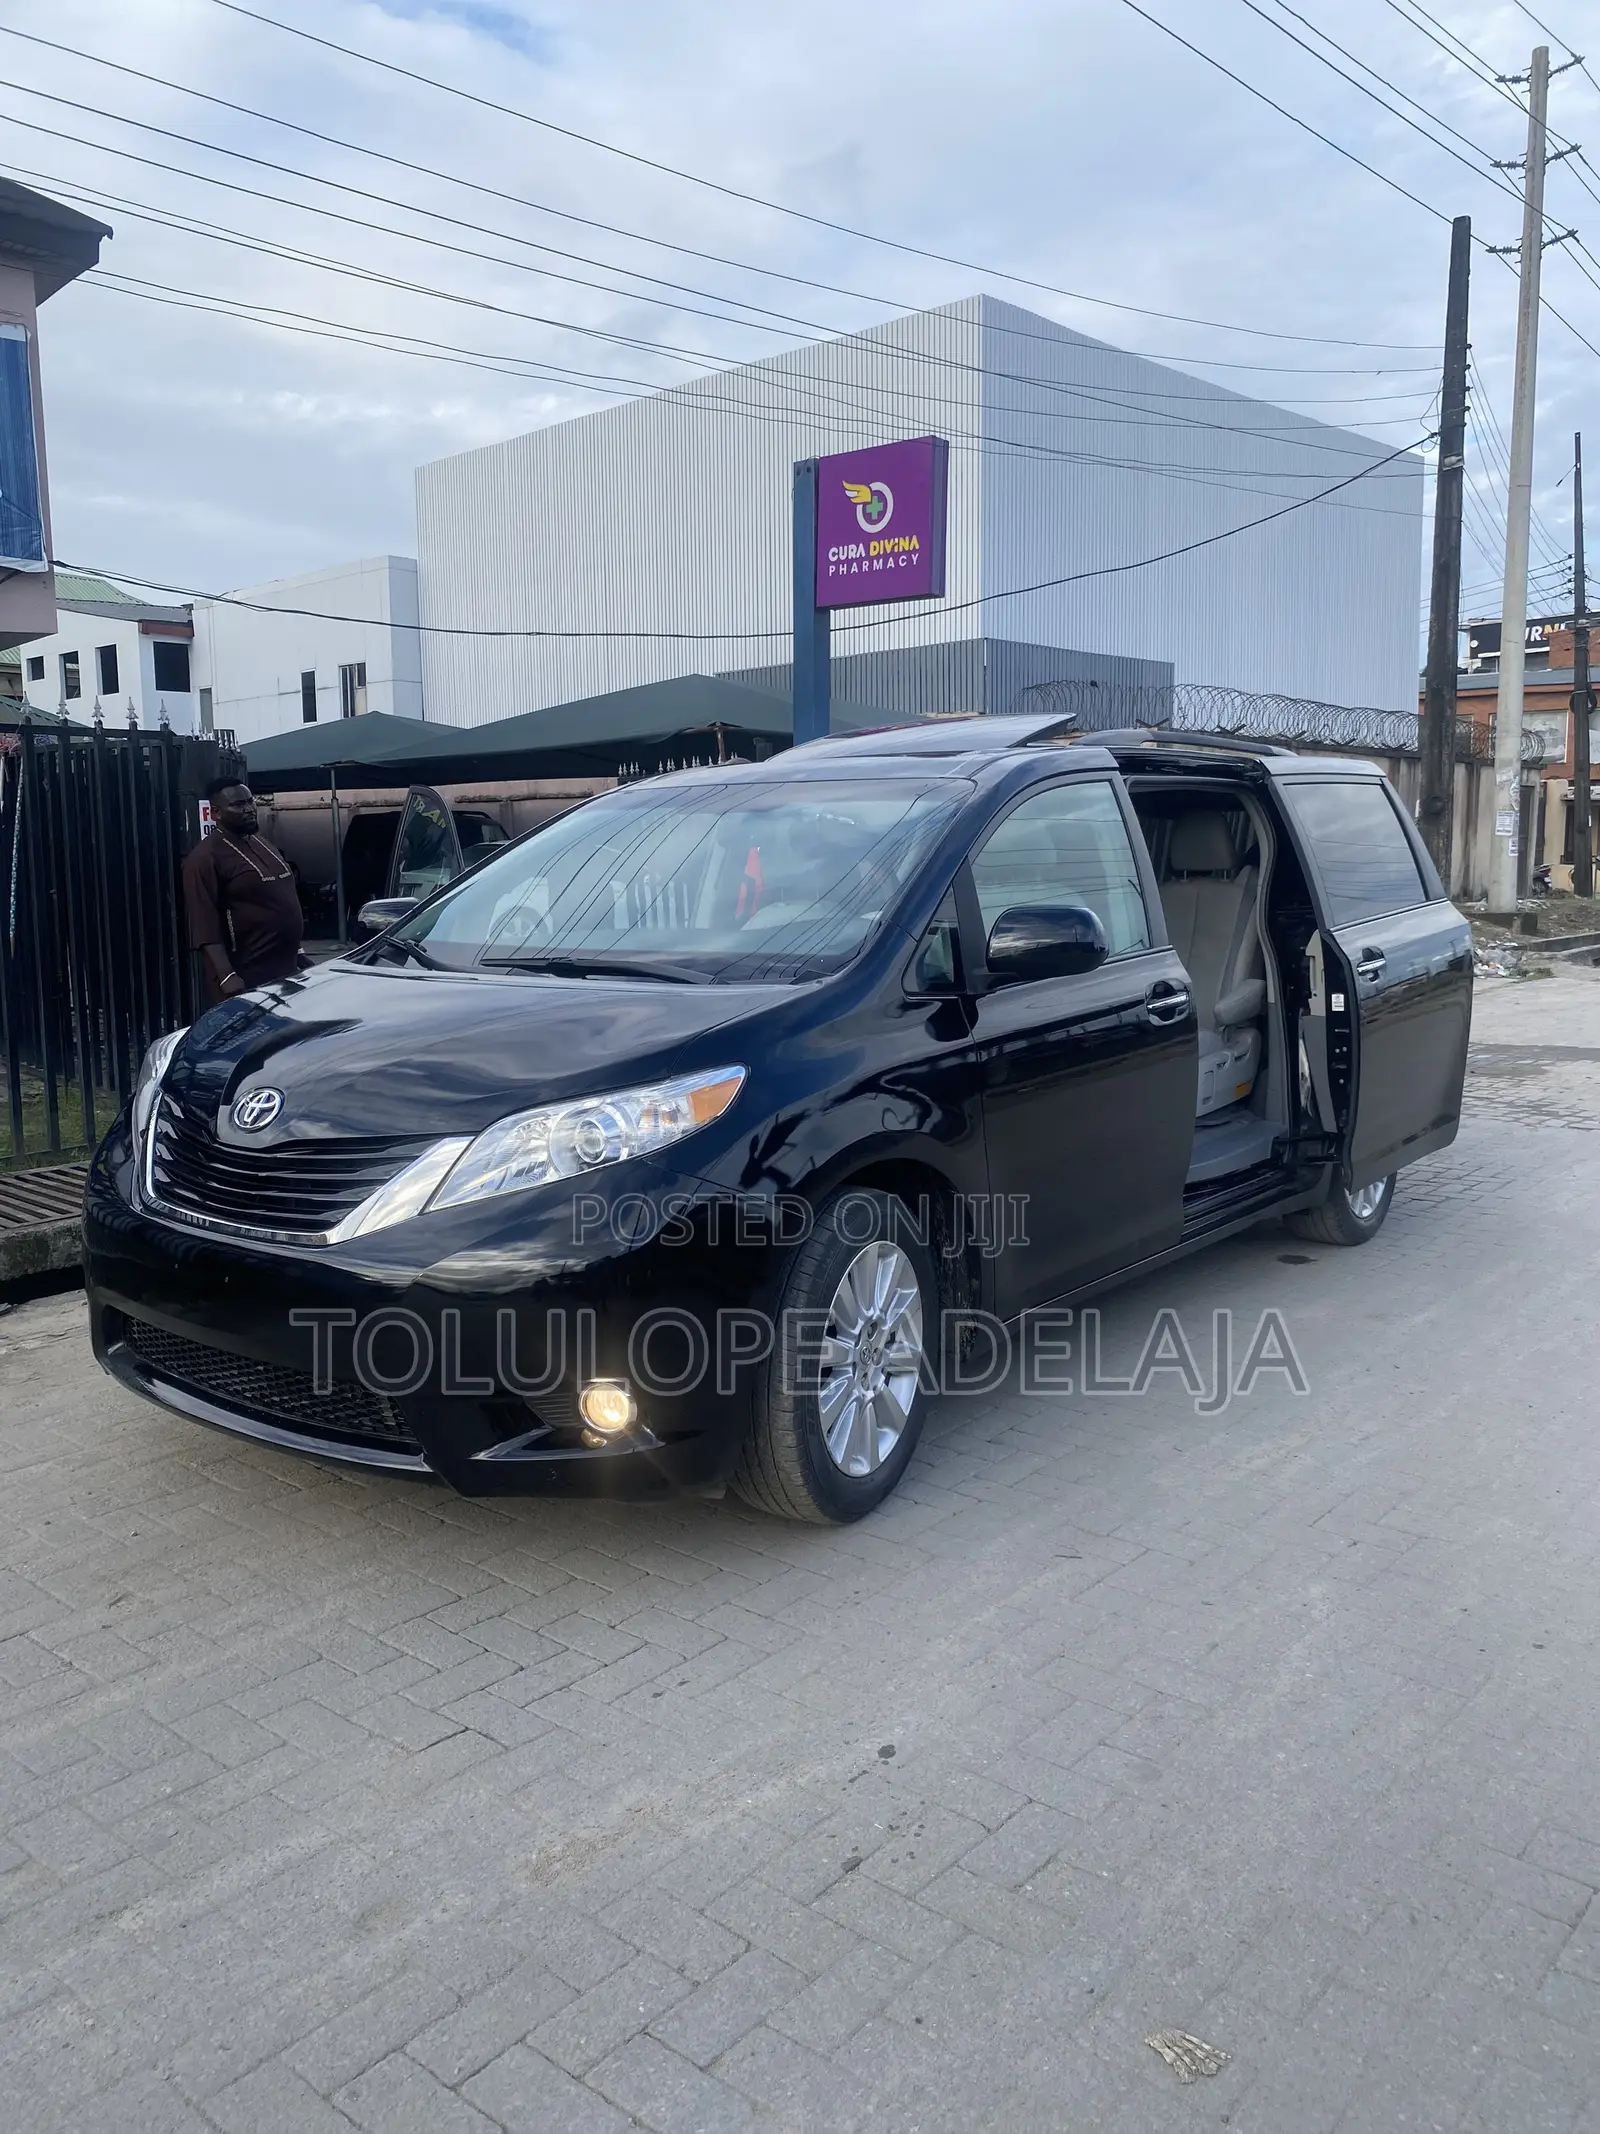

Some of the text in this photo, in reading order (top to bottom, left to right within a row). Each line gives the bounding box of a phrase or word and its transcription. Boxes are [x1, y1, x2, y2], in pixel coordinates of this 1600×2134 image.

[828, 534, 920, 562] CURA DIVINA
[828, 553, 919, 577] PHARMACY
